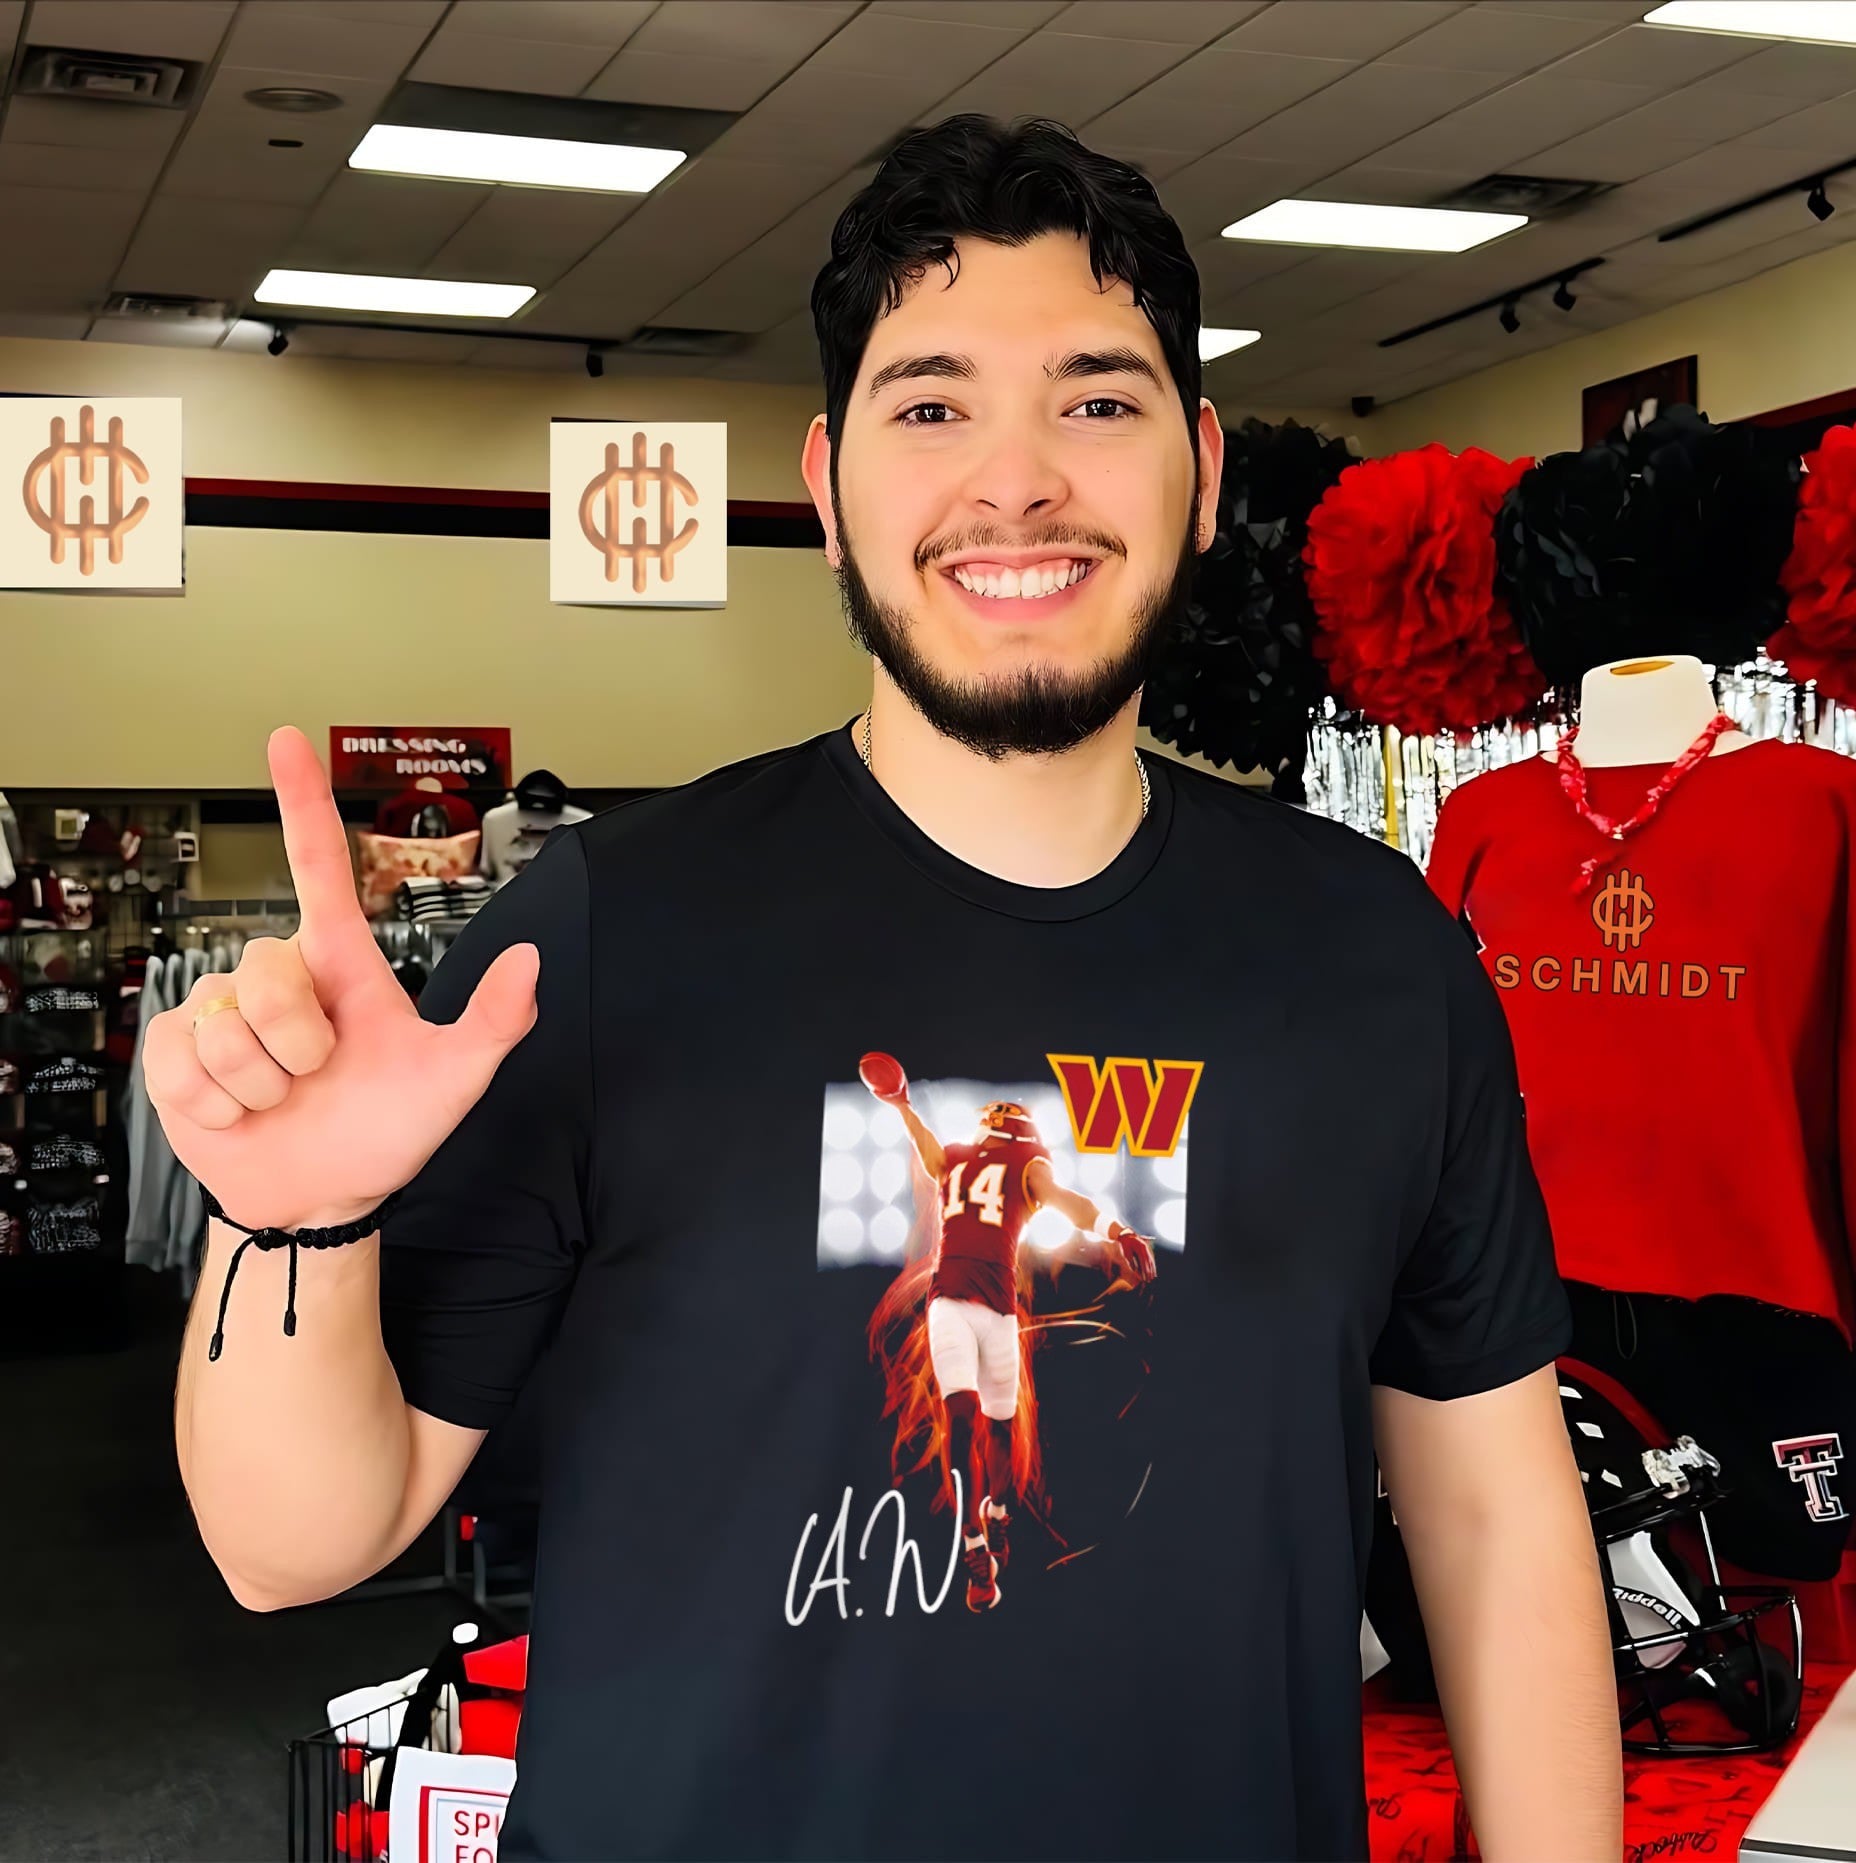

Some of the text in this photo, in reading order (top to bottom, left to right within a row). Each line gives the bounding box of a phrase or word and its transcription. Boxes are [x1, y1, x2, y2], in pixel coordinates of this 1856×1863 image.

[396, 758, 487, 775] ROOMS
[1493, 953, 1747, 1000] SCHMIDT
[1045, 1053, 1205, 1158] W
[942, 1160, 1008, 1228] 14
